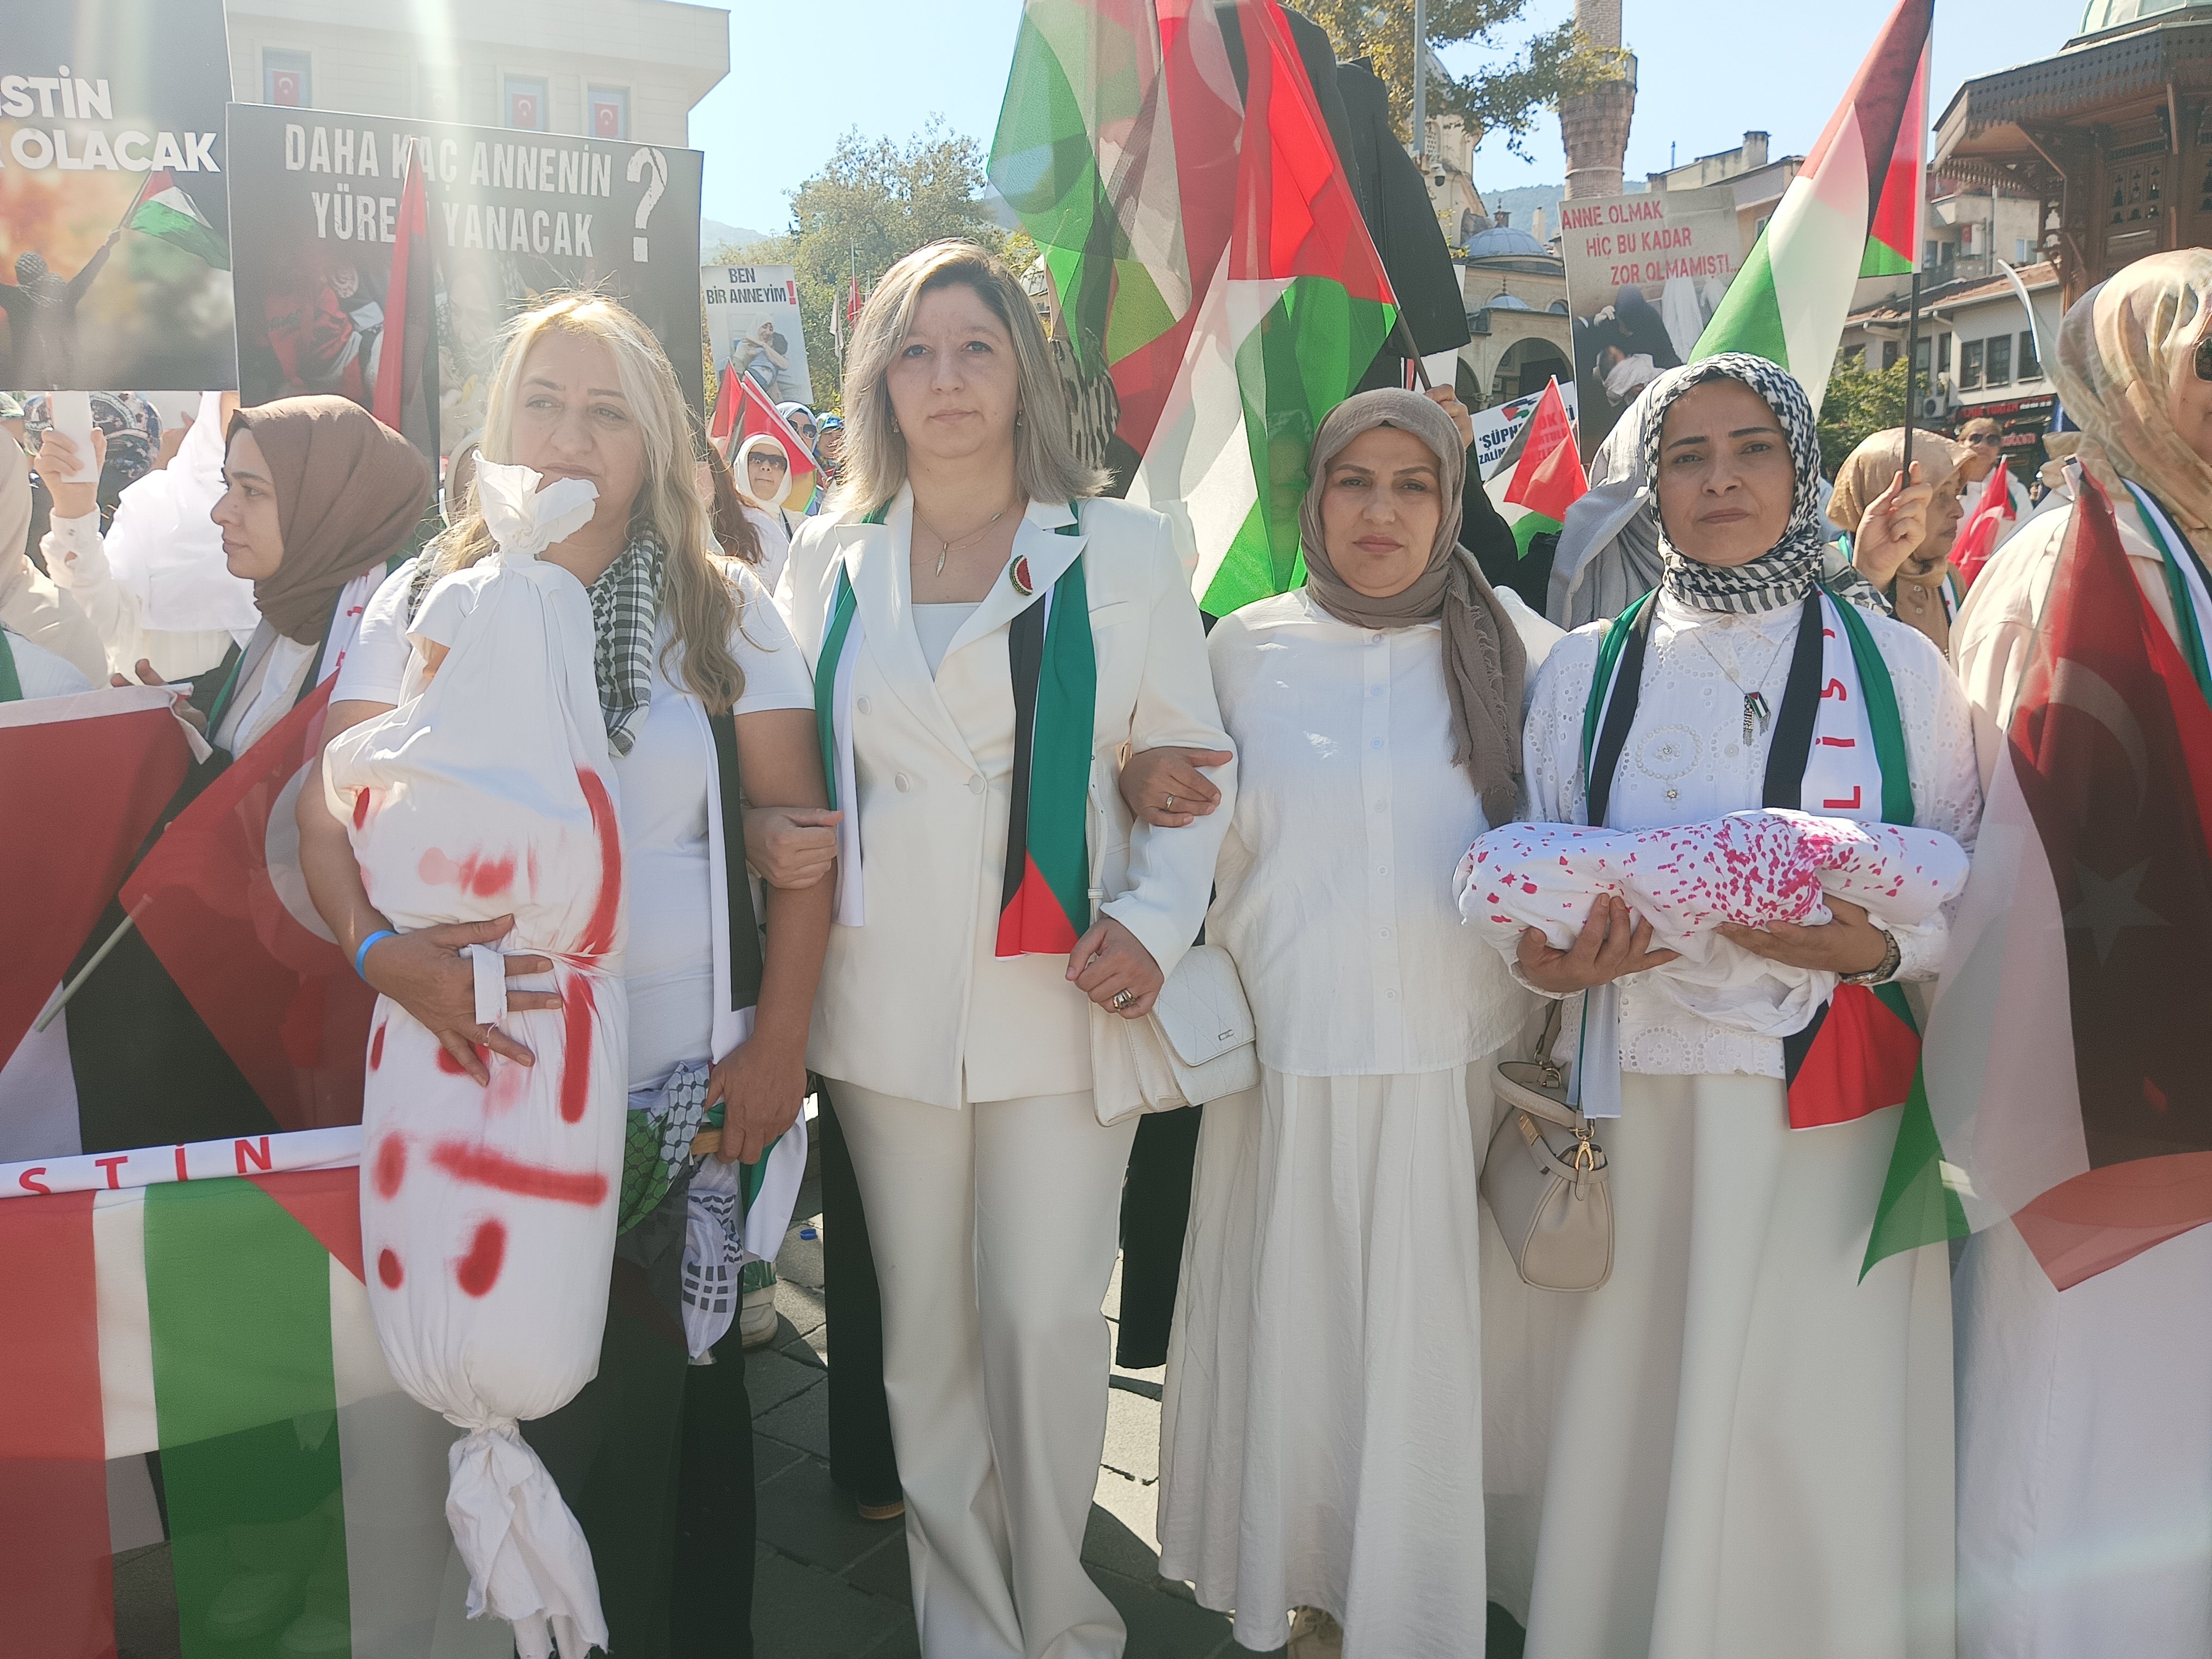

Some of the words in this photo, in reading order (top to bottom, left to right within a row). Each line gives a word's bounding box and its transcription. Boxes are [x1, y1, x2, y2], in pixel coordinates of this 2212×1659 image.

[0, 65, 113, 119] STİN
[11, 128, 221, 172] OLACAK
[286, 124, 379, 177] DAHA
[392, 133, 458, 191] KAÇ
[470, 142, 611, 197] ANNENİN
[311, 183, 429, 244] YÜRE
[442, 202, 593, 257] YANACAK
[1562, 206, 1603, 230] ANNE
[1609, 200, 1664, 224] OLMAK
[1586, 233, 1612, 260] HİÇ
[1617, 233, 1636, 254] BU
[1642, 227, 1692, 251] KADAR
[728, 268, 755, 283] BEN
[1611, 263, 1640, 286] ZOR
[706, 285, 727, 304] BİR
[730, 280, 796, 304] ANNEYİM!
